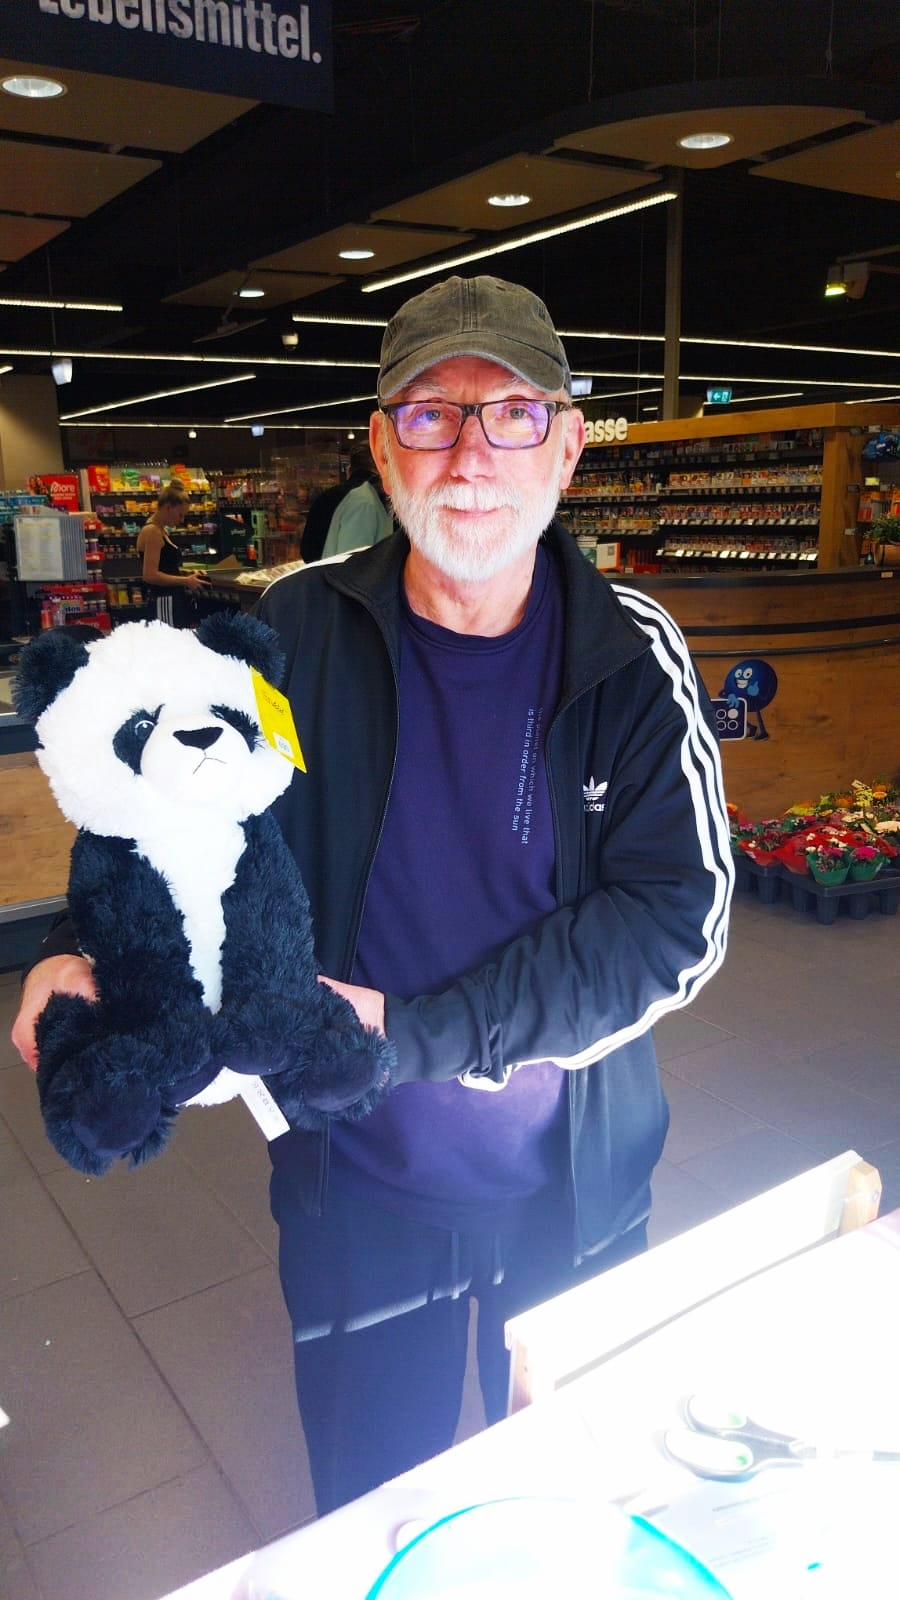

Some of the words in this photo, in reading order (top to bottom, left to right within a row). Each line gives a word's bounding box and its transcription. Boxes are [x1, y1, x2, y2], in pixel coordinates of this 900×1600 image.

[38, 0, 323, 64] ensmittel.
[584, 416, 628, 444] asse
[525, 718, 535, 738] third
[523, 739, 532, 748] in
[520, 749, 529, 773] order
[516, 775, 527, 796] from
[514, 798, 524, 812] the
[583, 801, 605, 811] das
[511, 815, 520, 831] sun
[524, 809, 533, 825] live
[521, 827, 531, 844] that
